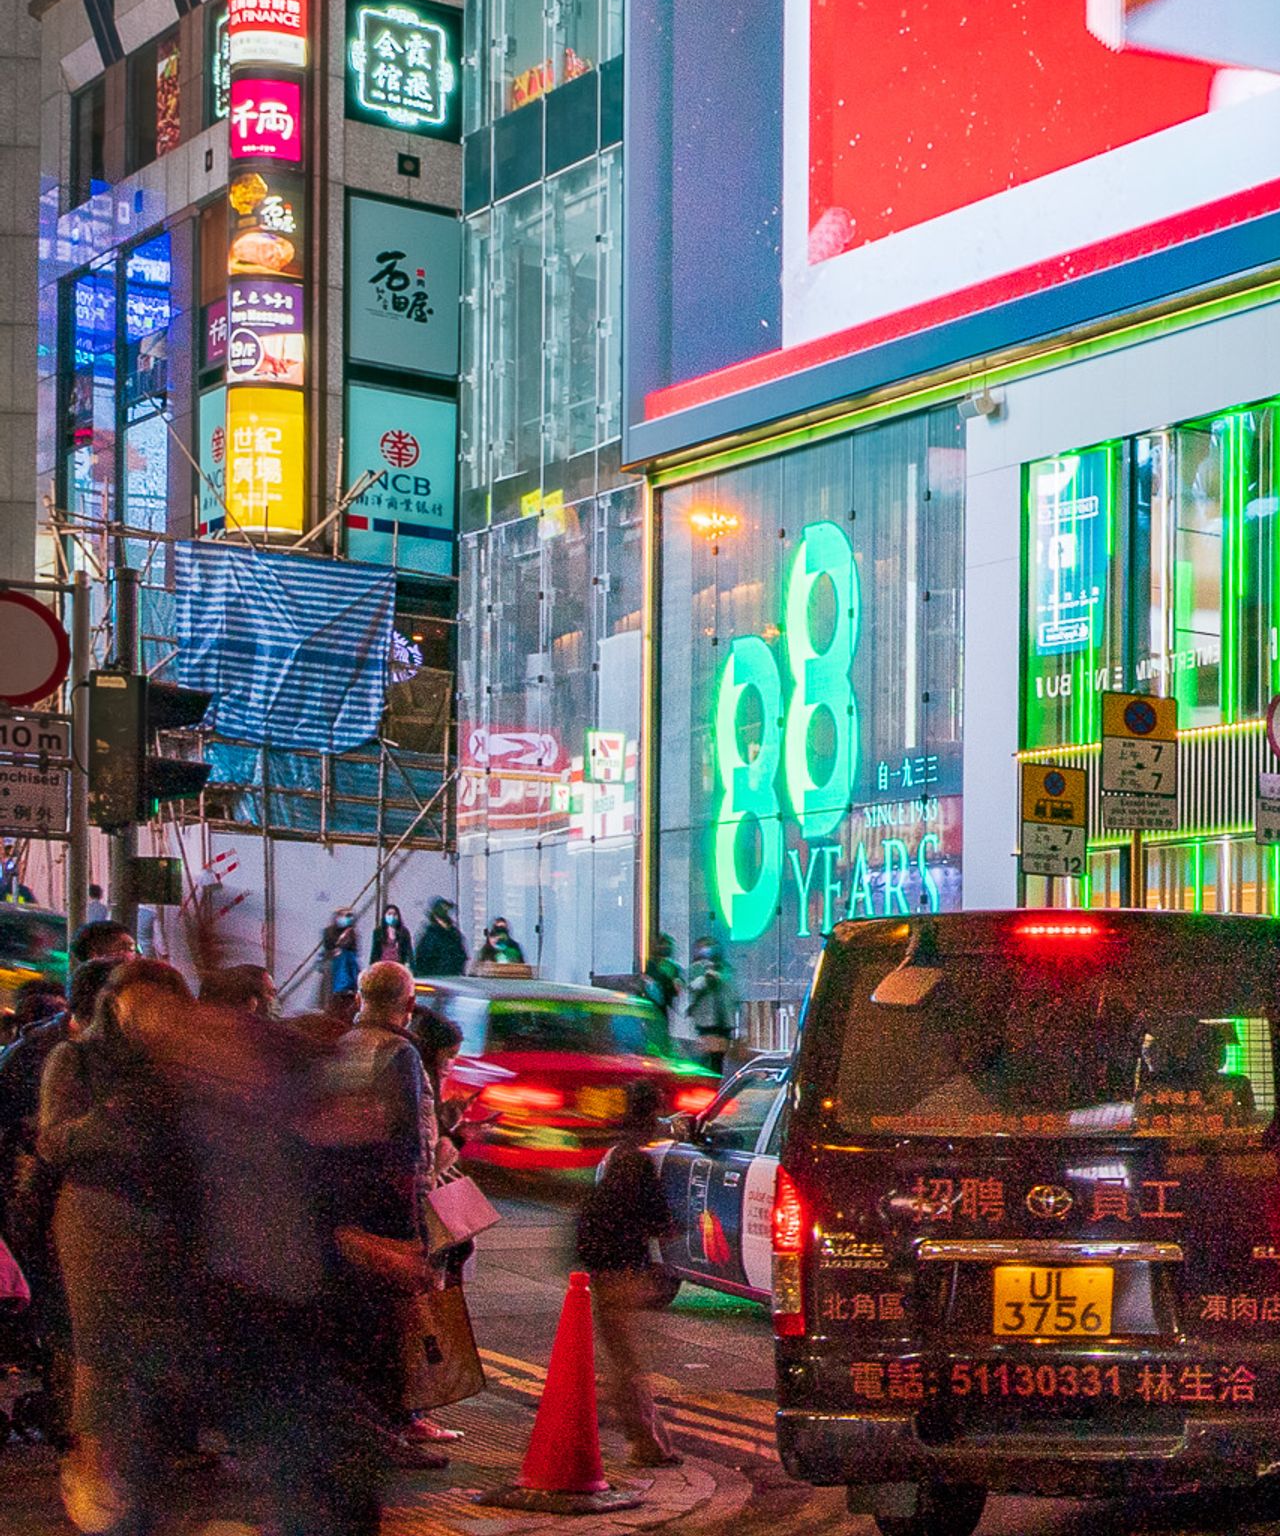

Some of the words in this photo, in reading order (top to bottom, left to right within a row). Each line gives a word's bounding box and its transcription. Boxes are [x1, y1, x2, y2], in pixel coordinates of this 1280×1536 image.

[242, 9, 300, 28] FINANCE
[233, 427, 282, 454] 世紀
[38, 733, 62, 750] m
[1151, 745, 1163, 762] 7
[1151, 772, 1163, 790] 7
[863, 802, 905, 827] SINCE
[1061, 829, 1074, 846] 7
[1063, 857, 1082, 873] 12
[788, 831, 941, 937] YEARS
[912, 1178, 1005, 1222] 招聘
[1087, 1177, 1184, 1222] 員工
[1029, 1271, 1077, 1302] UL
[822, 1292, 905, 1321] 北角區
[1002, 1302, 1102, 1333] 3756
[951, 1365, 1121, 1398] 51130331
